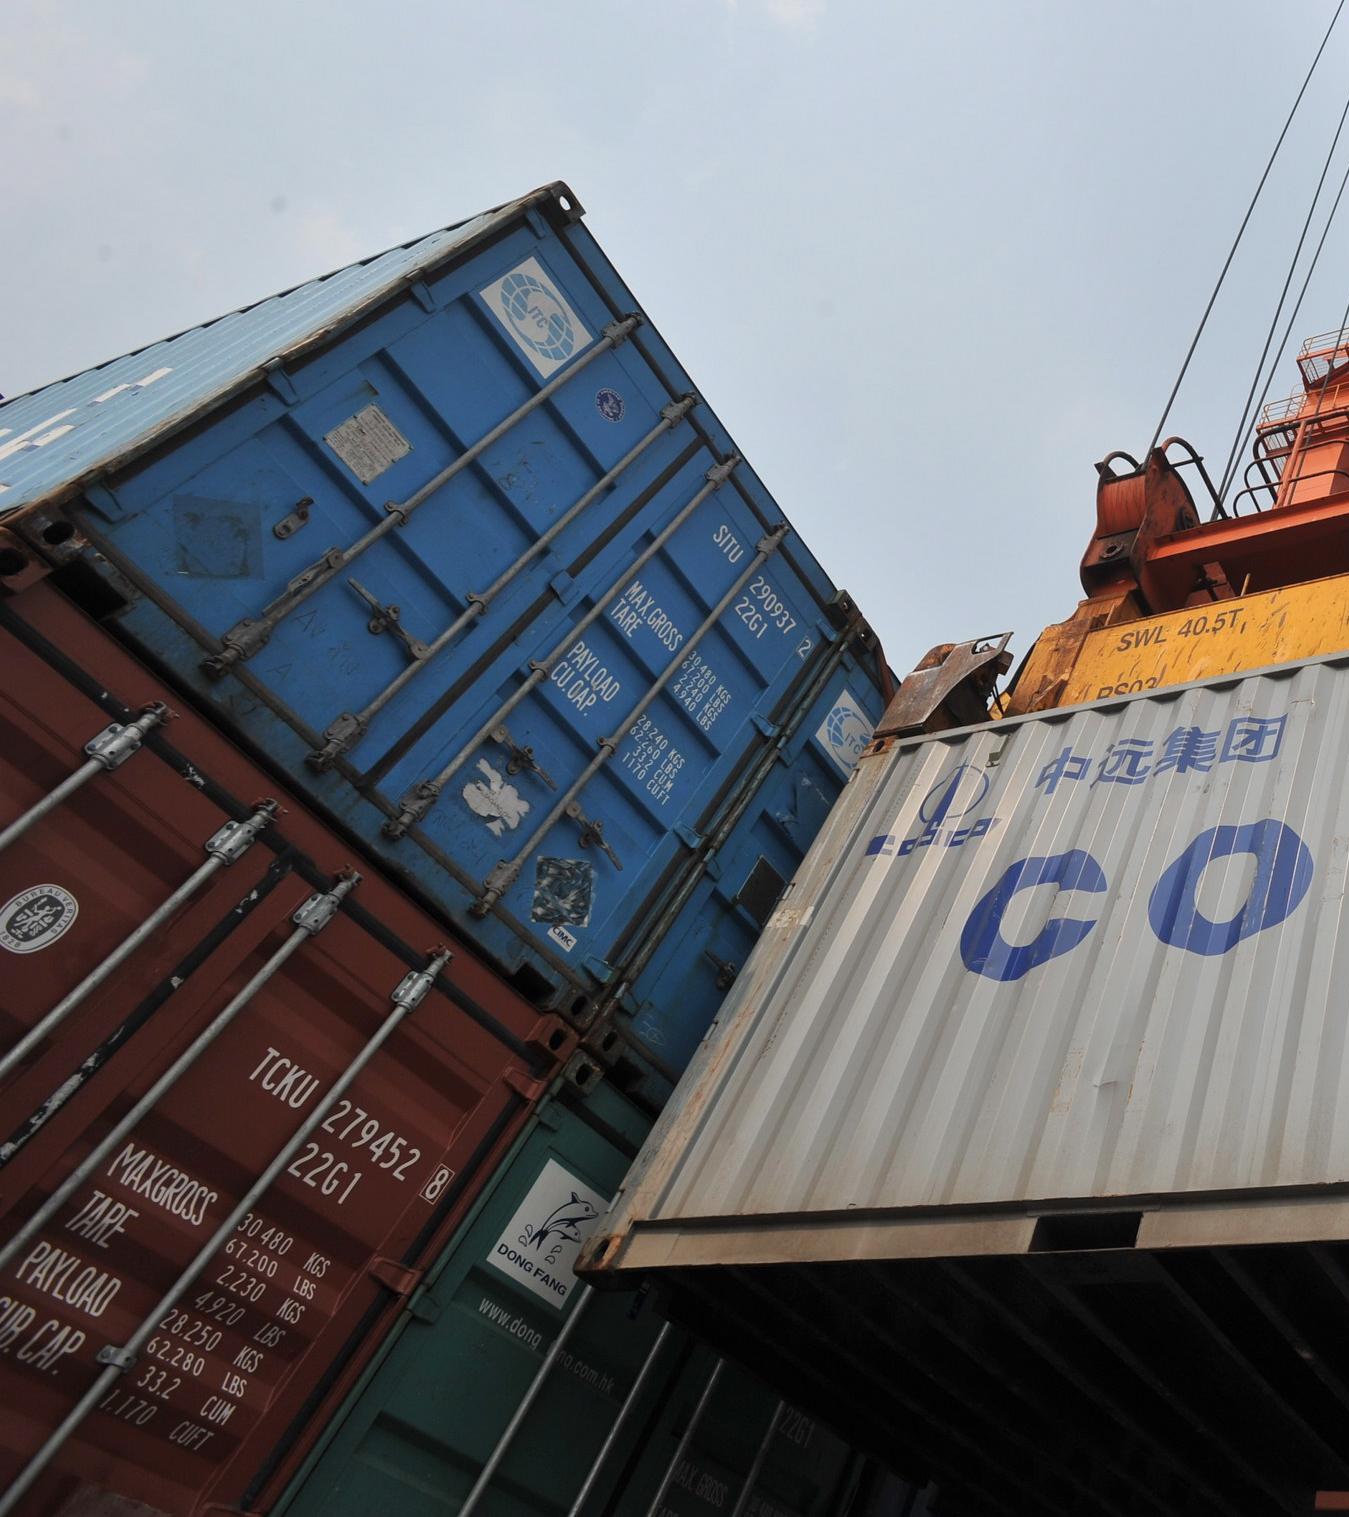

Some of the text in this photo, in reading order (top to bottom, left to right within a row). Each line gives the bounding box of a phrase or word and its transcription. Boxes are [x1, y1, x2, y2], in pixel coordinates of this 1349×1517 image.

[526, 305, 548, 329] ITC
[713, 525, 812, 657] SITU 290937 2
[734, 596, 768, 639] 22G1
[610, 598, 644, 638] TARE
[702, 703, 719, 722] KGS
[1116, 608, 1244, 652] SWL 40.5T
[567, 641, 620, 702] PAYLOAD
[667, 748, 686, 770] KGS
[696, 711, 713, 731] LBS
[709, 693, 725, 713] LBS
[716, 685, 732, 705] KGS
[660, 758, 679, 779] LBS
[1034, 713, 1289, 796] 中远集团
[15, 888, 73, 934] BUREAU VERITAS
[249, 1047, 450, 1200] TCKU 279452 8
[287, 1142, 362, 1205] 22G1
[107, 1142, 218, 1226] MAXGROSS
[303, 1252, 331, 1278] KGS
[65, 1190, 305, 1324] TARE 2.230 KGS
[225, 1238, 317, 1300] 67.200 LBS
[496, 1243, 568, 1296] DONG FANG
[15, 1240, 264, 1373] PAYLOAD 28.250 KGS
[253, 1322, 286, 1347] LBS
[0, 1296, 236, 1426] UB. CAP. 33.2 CUM
[146, 1336, 248, 1398] 62.280 LBS
